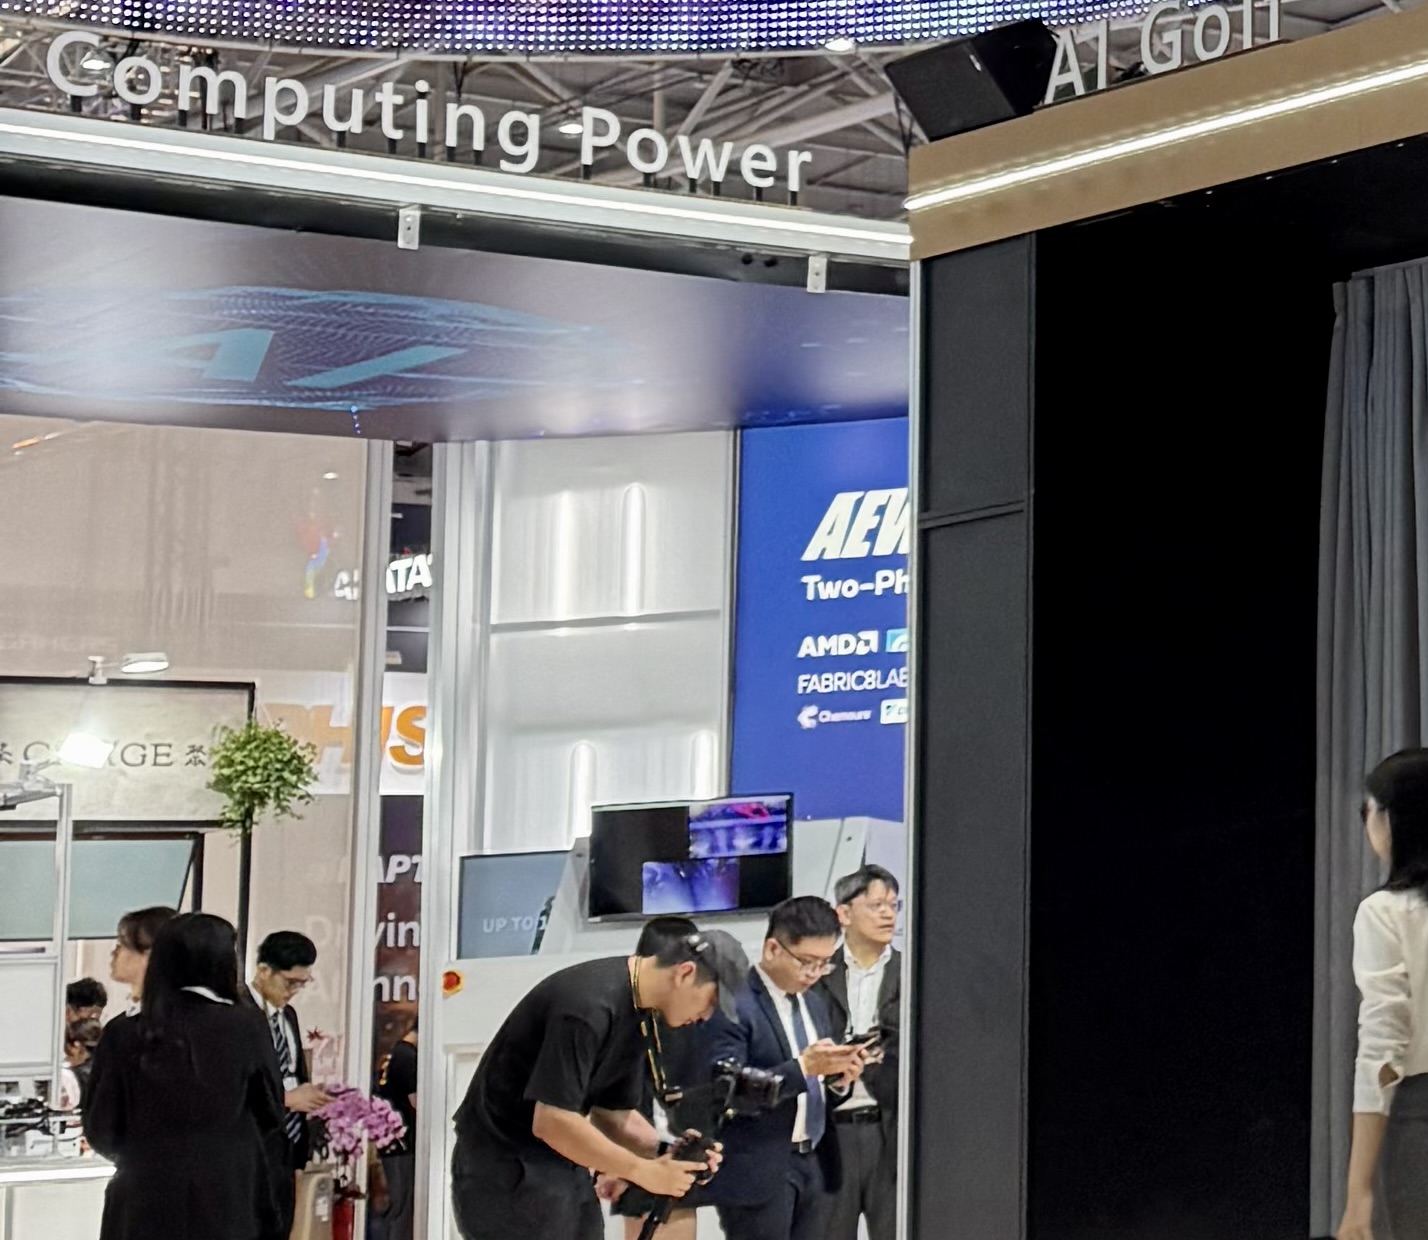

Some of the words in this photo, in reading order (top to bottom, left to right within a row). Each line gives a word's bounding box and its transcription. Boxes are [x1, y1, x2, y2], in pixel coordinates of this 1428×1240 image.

[1044, 20, 1108, 104] AI
[46, 31, 541, 172] Computing
[581, 106, 812, 190] Power
[797, 633, 857, 658] AMD
[483, 917, 507, 933] UP
[511, 916, 533, 931] TO
